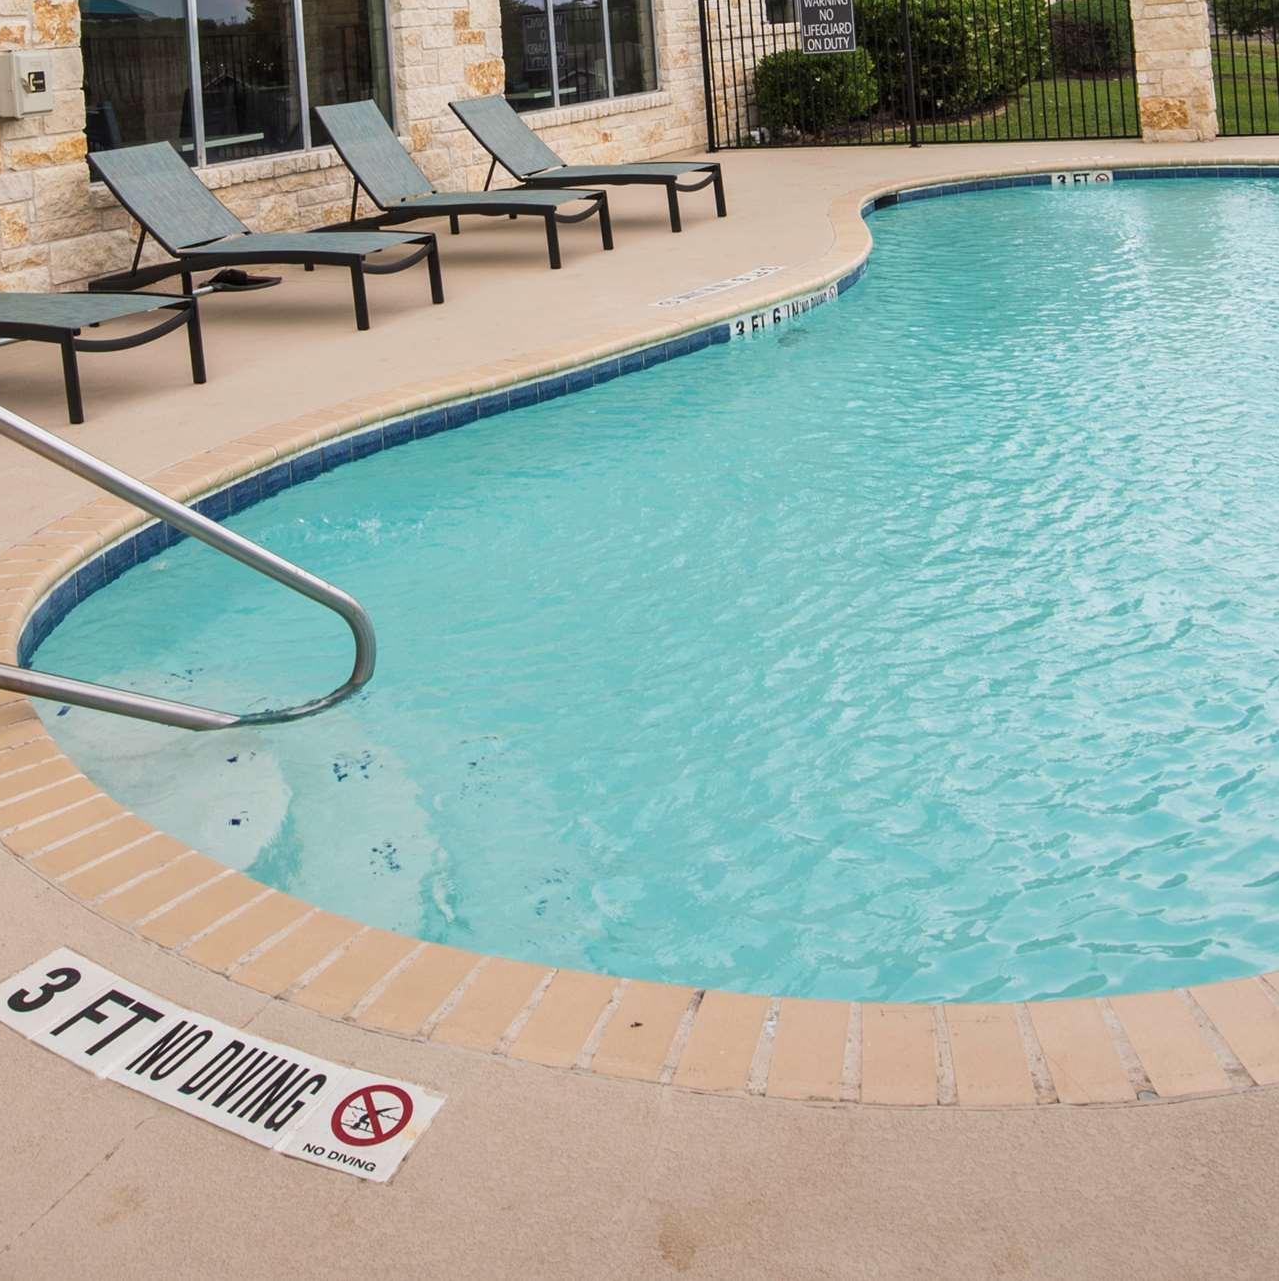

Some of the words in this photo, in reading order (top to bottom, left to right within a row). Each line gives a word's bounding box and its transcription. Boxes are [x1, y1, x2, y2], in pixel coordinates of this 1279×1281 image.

[819, 8, 834, 21] NO
[803, 22, 852, 37] LIFEGUARD
[808, 38, 822, 51] ON
[824, 37, 850, 50] DUTY
[736, 320, 745, 335] 3
[751, 313, 766, 332] FT
[773, 307, 781, 324] 6
[786, 301, 799, 318] IN
[7, 967, 82, 1013] 3
[50, 989, 164, 1056] FT
[126, 1020, 213, 1081] NO
[177, 1039, 327, 1132] DIVING
[303, 1142, 325, 1157] NO
[327, 1150, 377, 1173] DIVING
